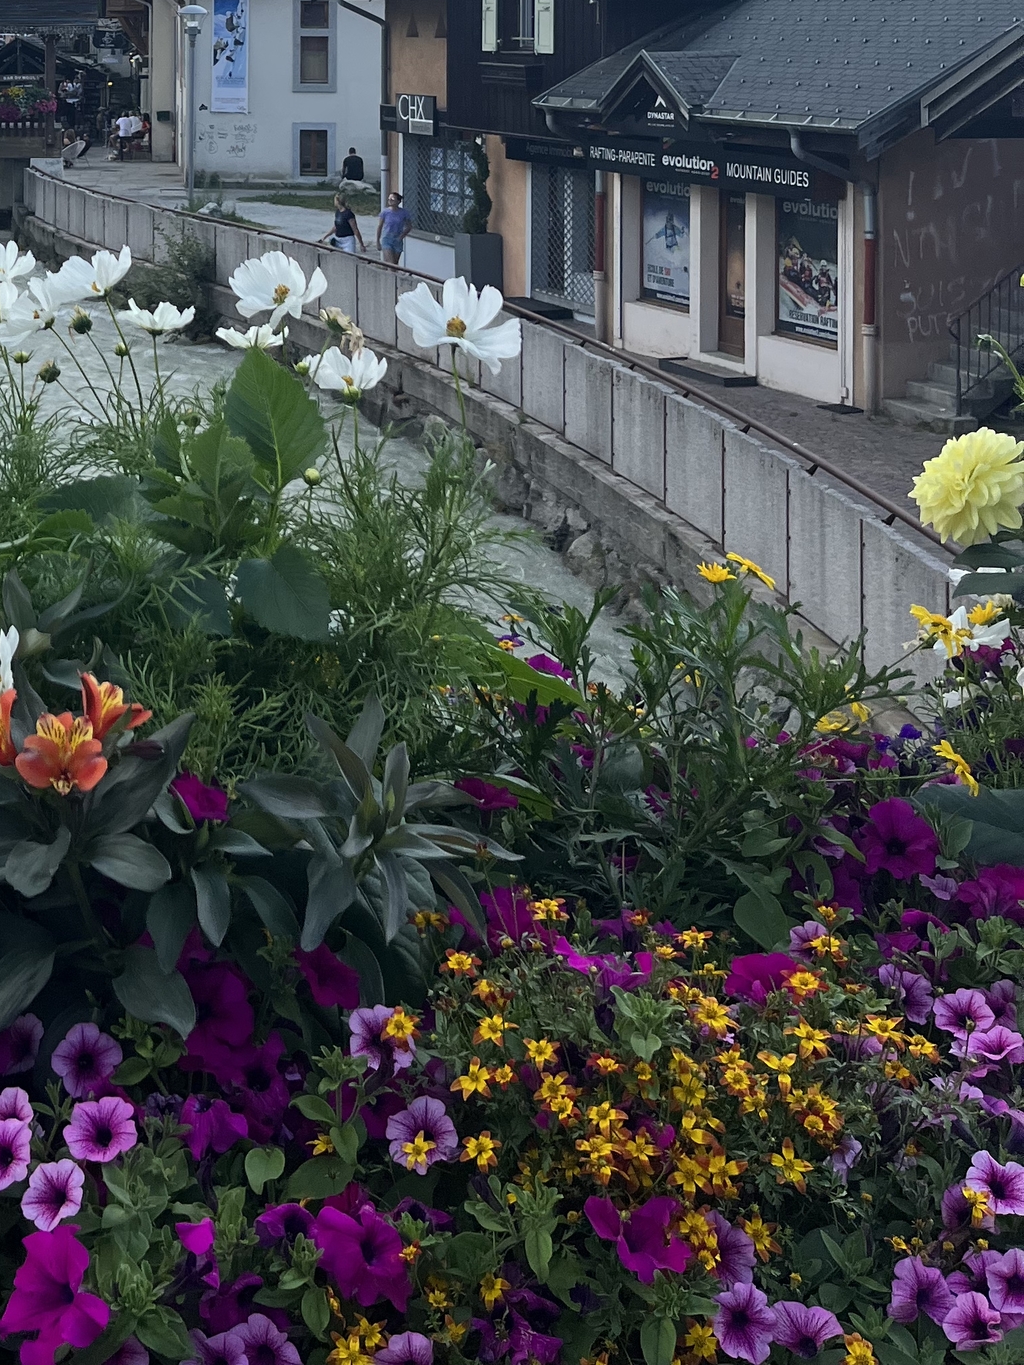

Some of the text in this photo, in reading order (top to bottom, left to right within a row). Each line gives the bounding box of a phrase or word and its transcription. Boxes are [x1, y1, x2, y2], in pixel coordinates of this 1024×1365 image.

[398, 94, 425, 120] CHX
[647, 111, 675, 120] DYNASTAR
[589, 145, 656, 167] RAFTING-PARAPENTE
[726, 162, 772, 182] MOUNTAIN
[773, 168, 809, 187] GUIDES
